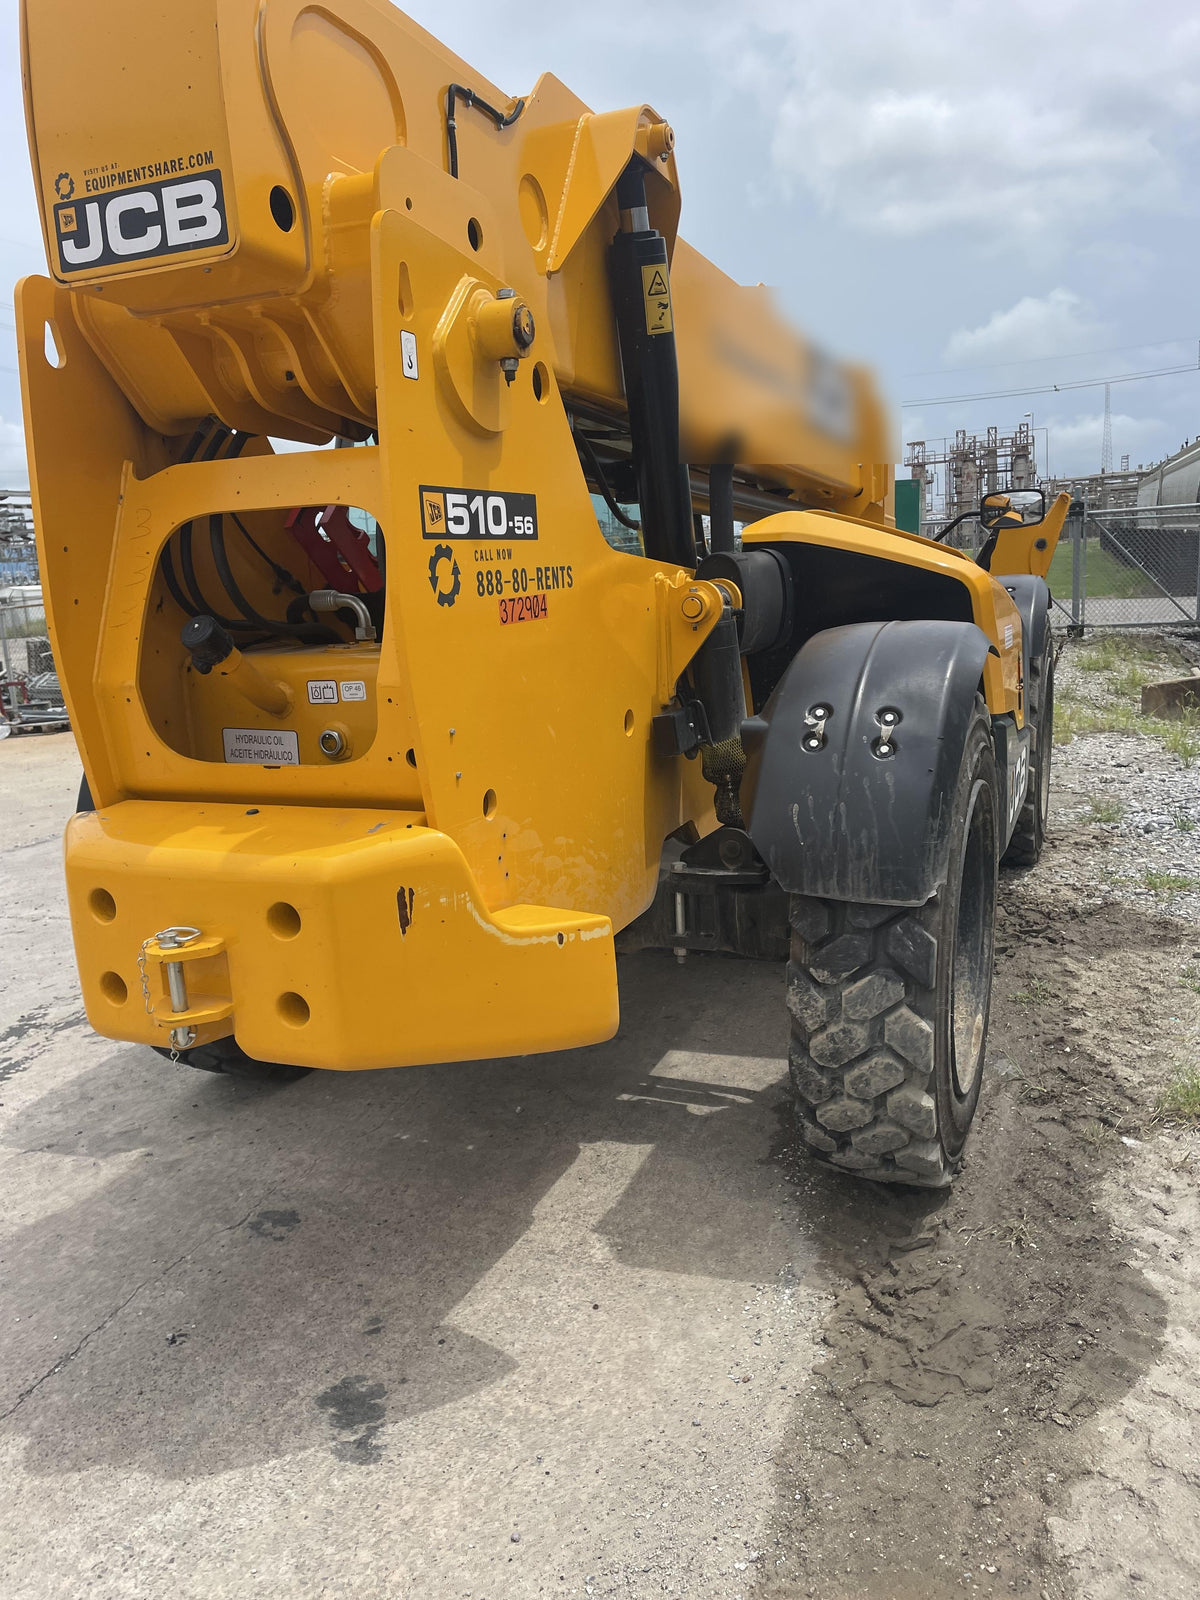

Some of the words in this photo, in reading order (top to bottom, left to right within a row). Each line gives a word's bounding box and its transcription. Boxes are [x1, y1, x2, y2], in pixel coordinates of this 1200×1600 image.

[83, 168, 99, 176] VISIT
[85, 151, 214, 192] EQUIPMENTSHARE.COM
[61, 179, 222, 264] JCB
[427, 501, 442, 523] JCB
[446, 493, 534, 535] 510-56
[474, 549, 494, 562] CALL
[496, 548, 512, 560] NOW
[476, 565, 573, 597] 888-80-RENTS
[500, 593, 547, 624] 372904
[235, 734, 272, 745] HYDRAULIC
[273, 736, 284, 746] OIL
[230, 748, 252, 759] ACEITE
